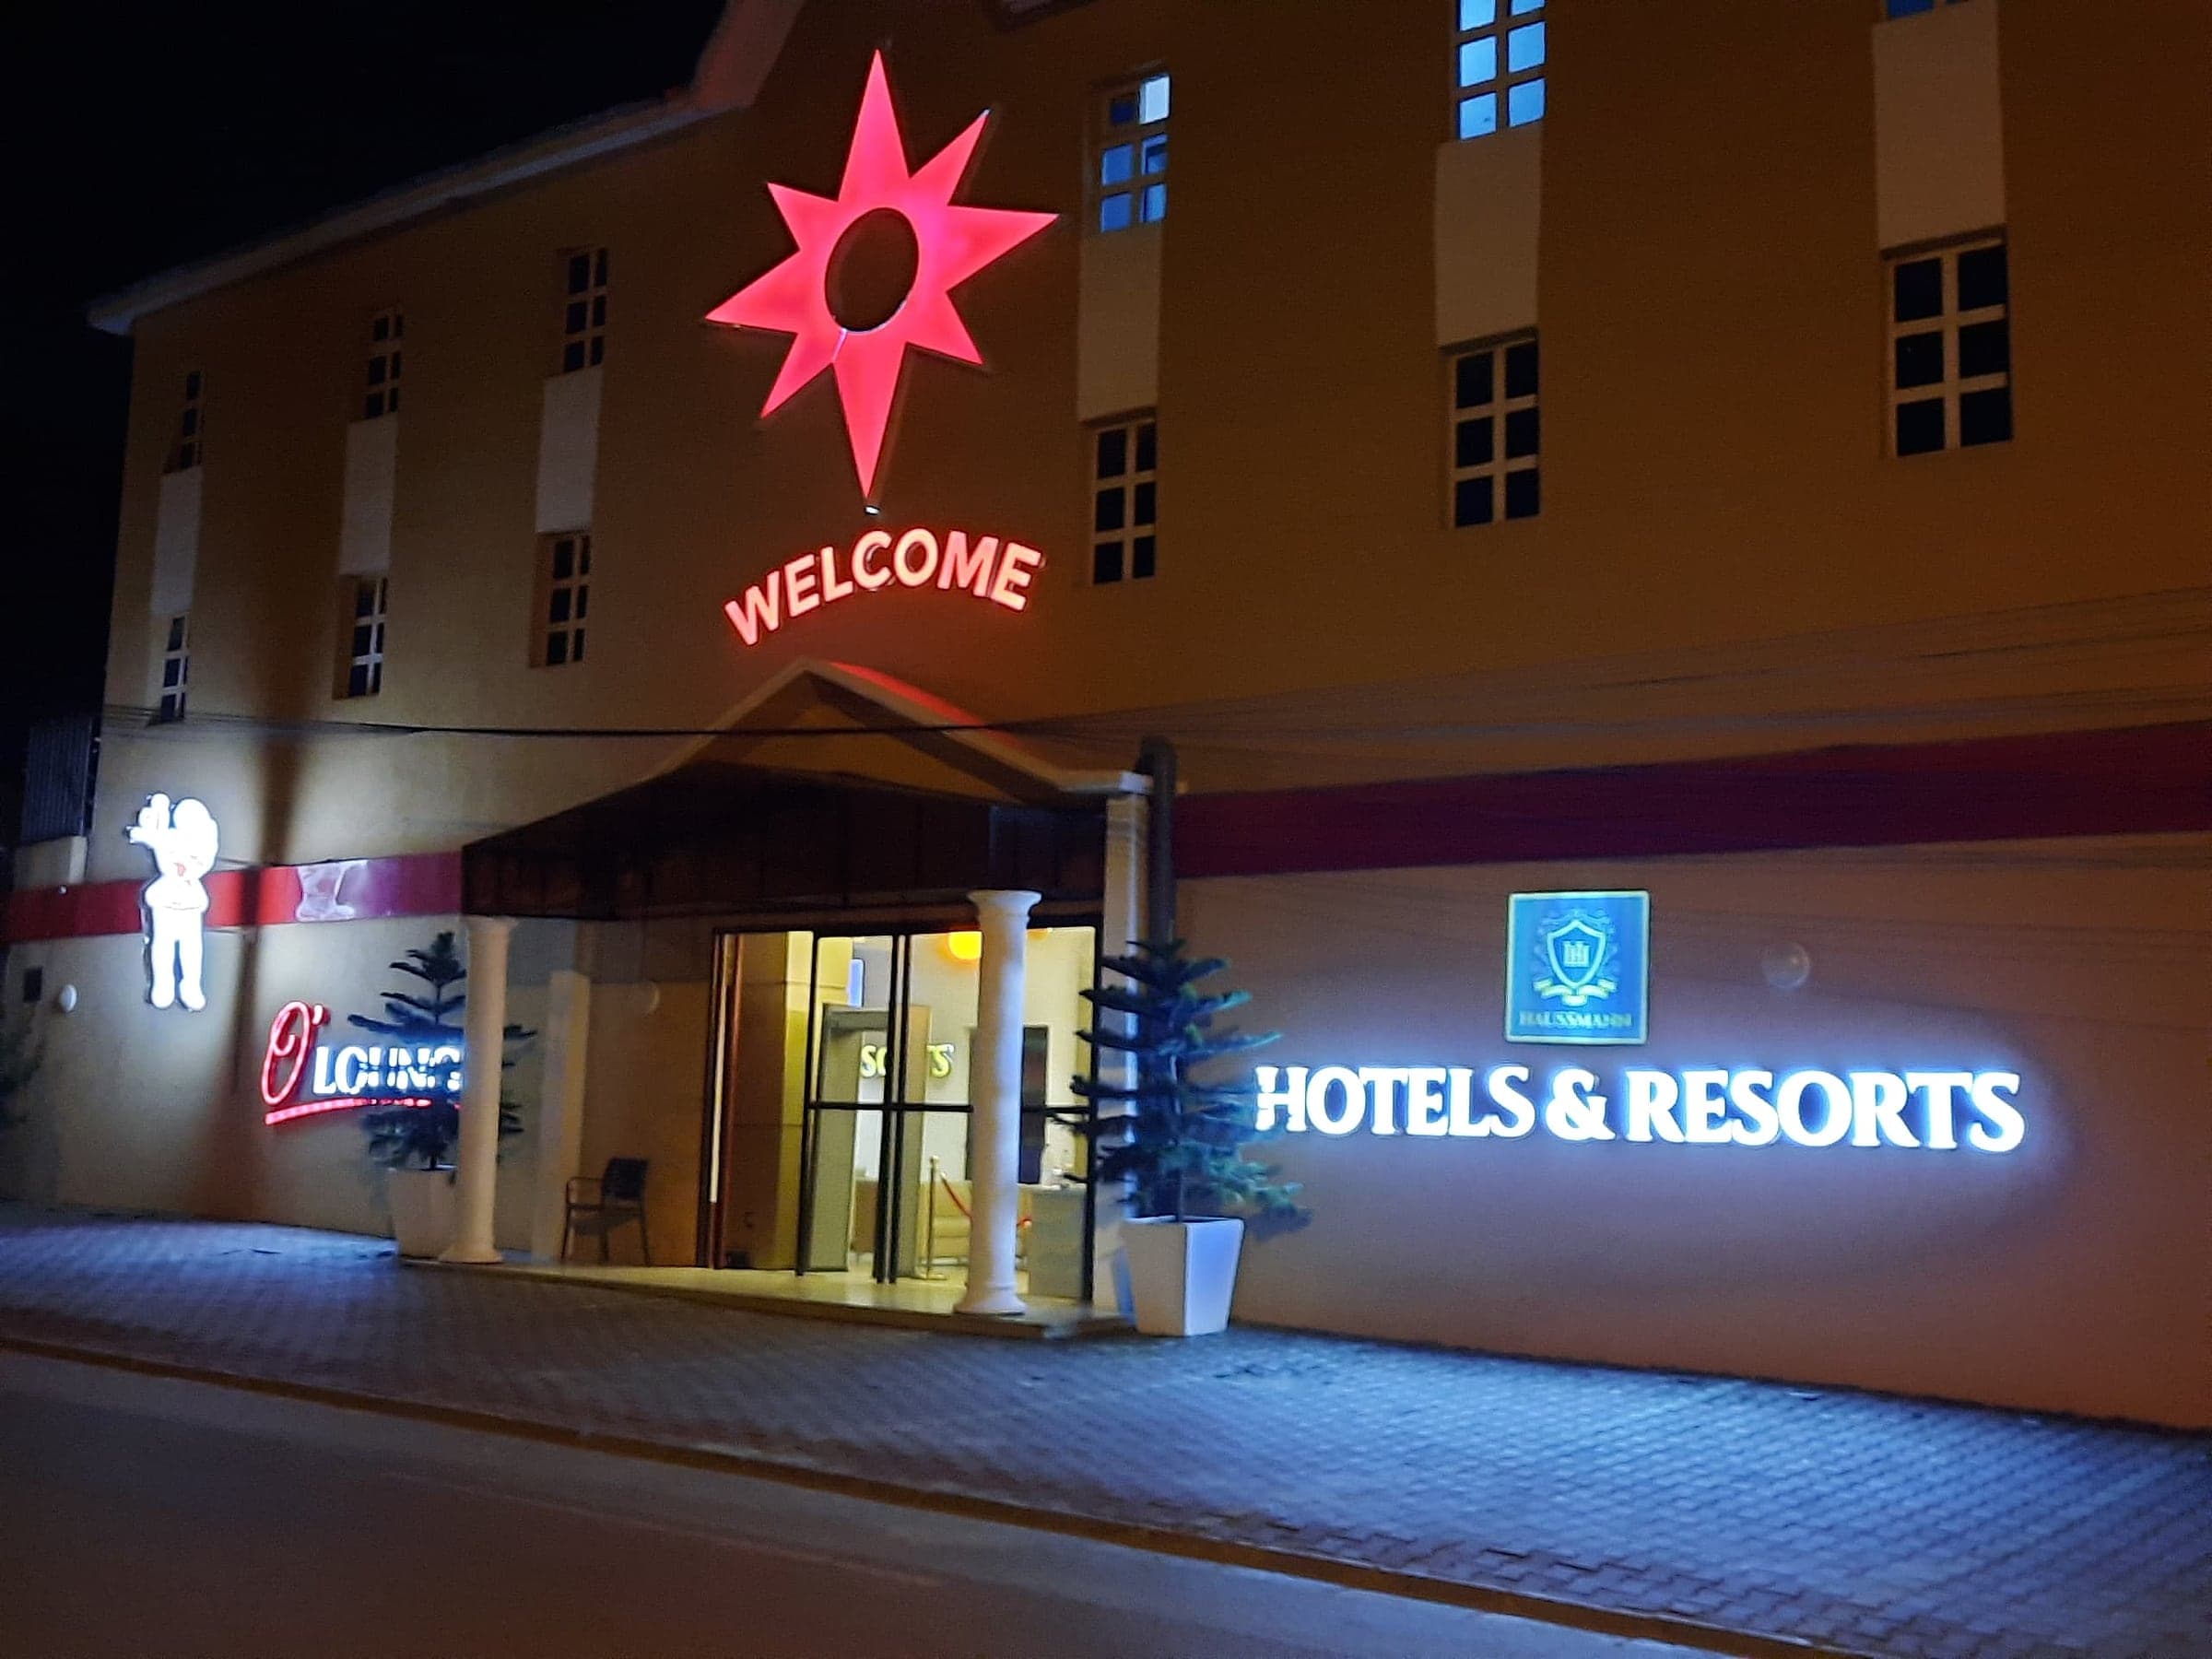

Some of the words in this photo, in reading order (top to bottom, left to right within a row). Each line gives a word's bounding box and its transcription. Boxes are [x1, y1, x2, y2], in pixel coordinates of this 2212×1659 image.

[724, 528, 1043, 646] WELCOME
[1257, 1066, 1535, 1137] HOTELS
[1546, 1069, 1616, 1141] &
[1627, 1070, 2025, 1152] RESORTS
